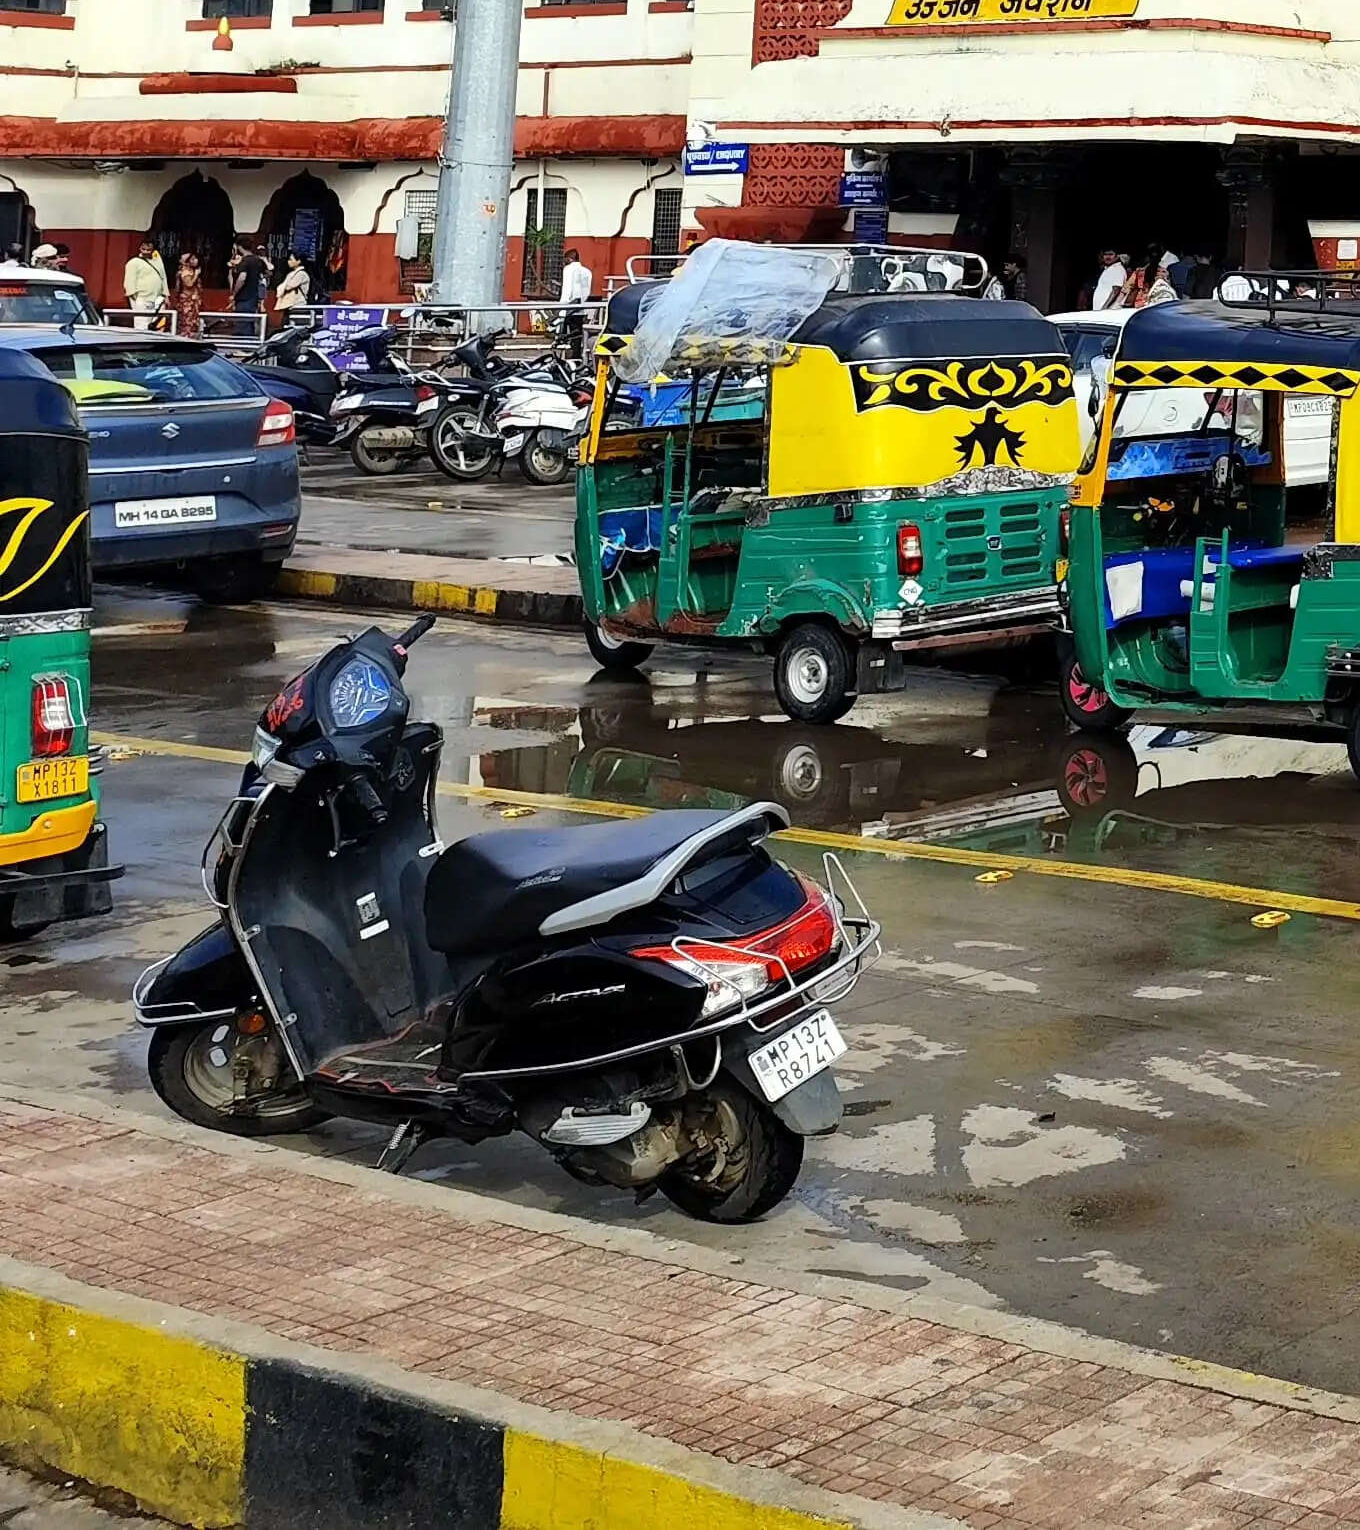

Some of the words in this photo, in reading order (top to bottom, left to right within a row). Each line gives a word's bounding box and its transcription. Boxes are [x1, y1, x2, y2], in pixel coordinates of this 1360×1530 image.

[715, 149, 746, 160] ENQUIRY
[118, 511, 141, 522] MH
[143, 510, 159, 520] 14
[32, 759, 77, 782] MP13Z
[33, 776, 77, 799] X1811
[766, 1017, 827, 1068] MP13Z
[776, 1038, 836, 1089] R8741
